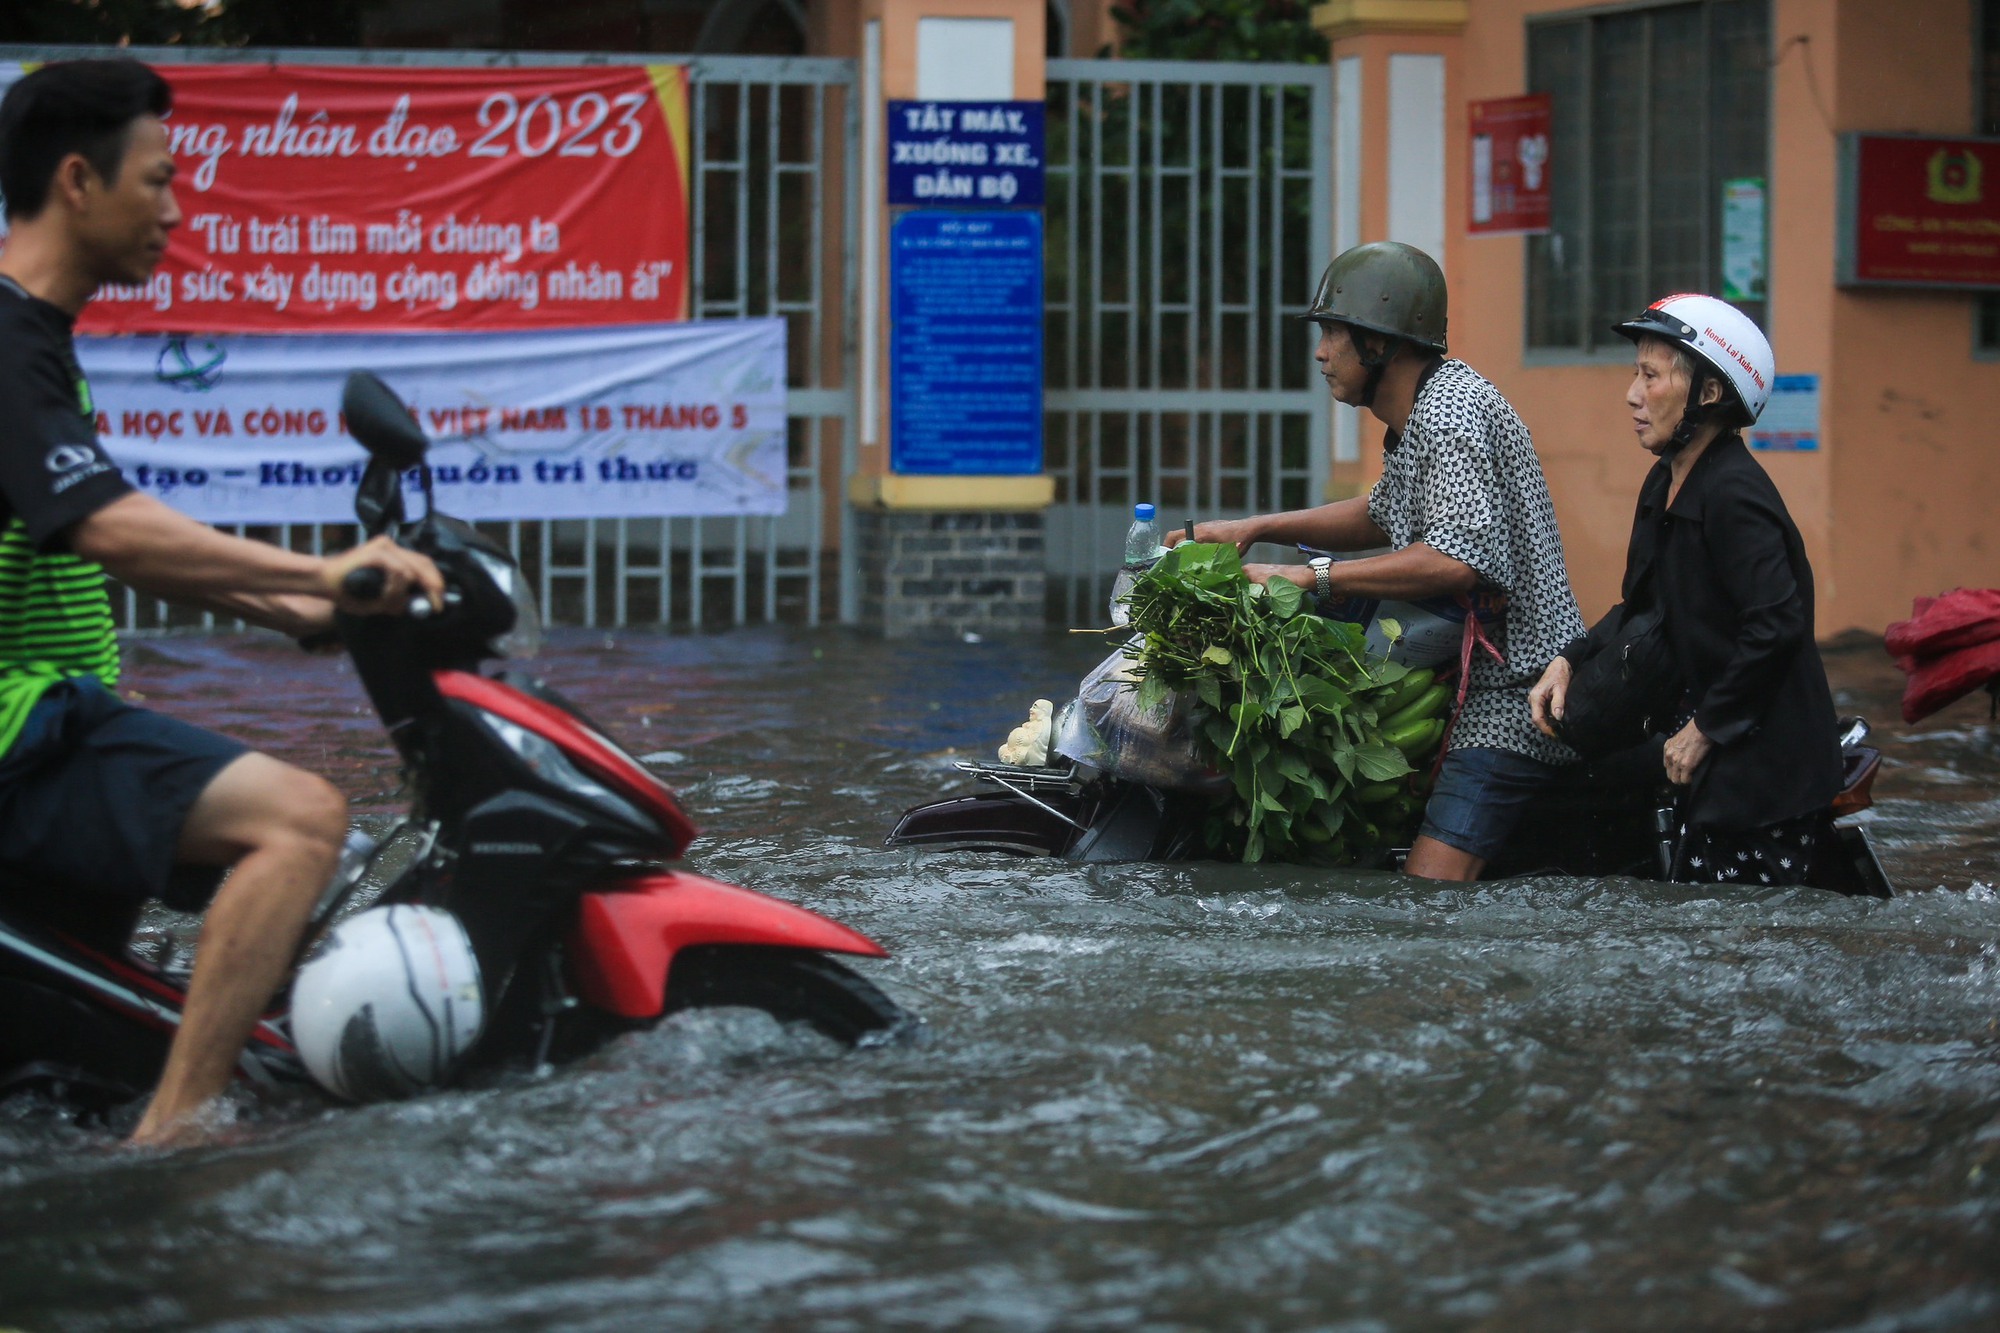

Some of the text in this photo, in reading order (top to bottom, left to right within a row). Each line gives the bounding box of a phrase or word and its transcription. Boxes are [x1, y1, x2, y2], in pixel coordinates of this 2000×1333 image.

[239, 92, 361, 156] nhân
[468, 91, 648, 157] 2023
[892, 136, 1040, 169] XUỐNG XE,
[249, 216, 300, 254] trái
[308, 214, 357, 254] tim
[430, 214, 522, 263] chúng
[529, 217, 560, 252] ta
[181, 262, 235, 302] sức
[242, 262, 295, 313] xây
[301, 261, 377, 311] dựng
[385, 262, 459, 312] cộng
[465, 258, 540, 311] đồng
[547, 261, 624, 300] nhân
[1704, 327, 1727, 349] Honda
[1726, 344, 1740, 358] Lai
[1737, 354, 1753, 374] Xuân
[122, 410, 184, 442] HỌC
[243, 403, 328, 437] CÔNG
[428, 403, 490, 440] VIỆT
[501, 407, 567, 433] NAM
[580, 404, 612, 432] 18
[622, 402, 722, 430] THÁNG
[732, 402, 749, 431] 5
[136, 464, 209, 494] tạo
